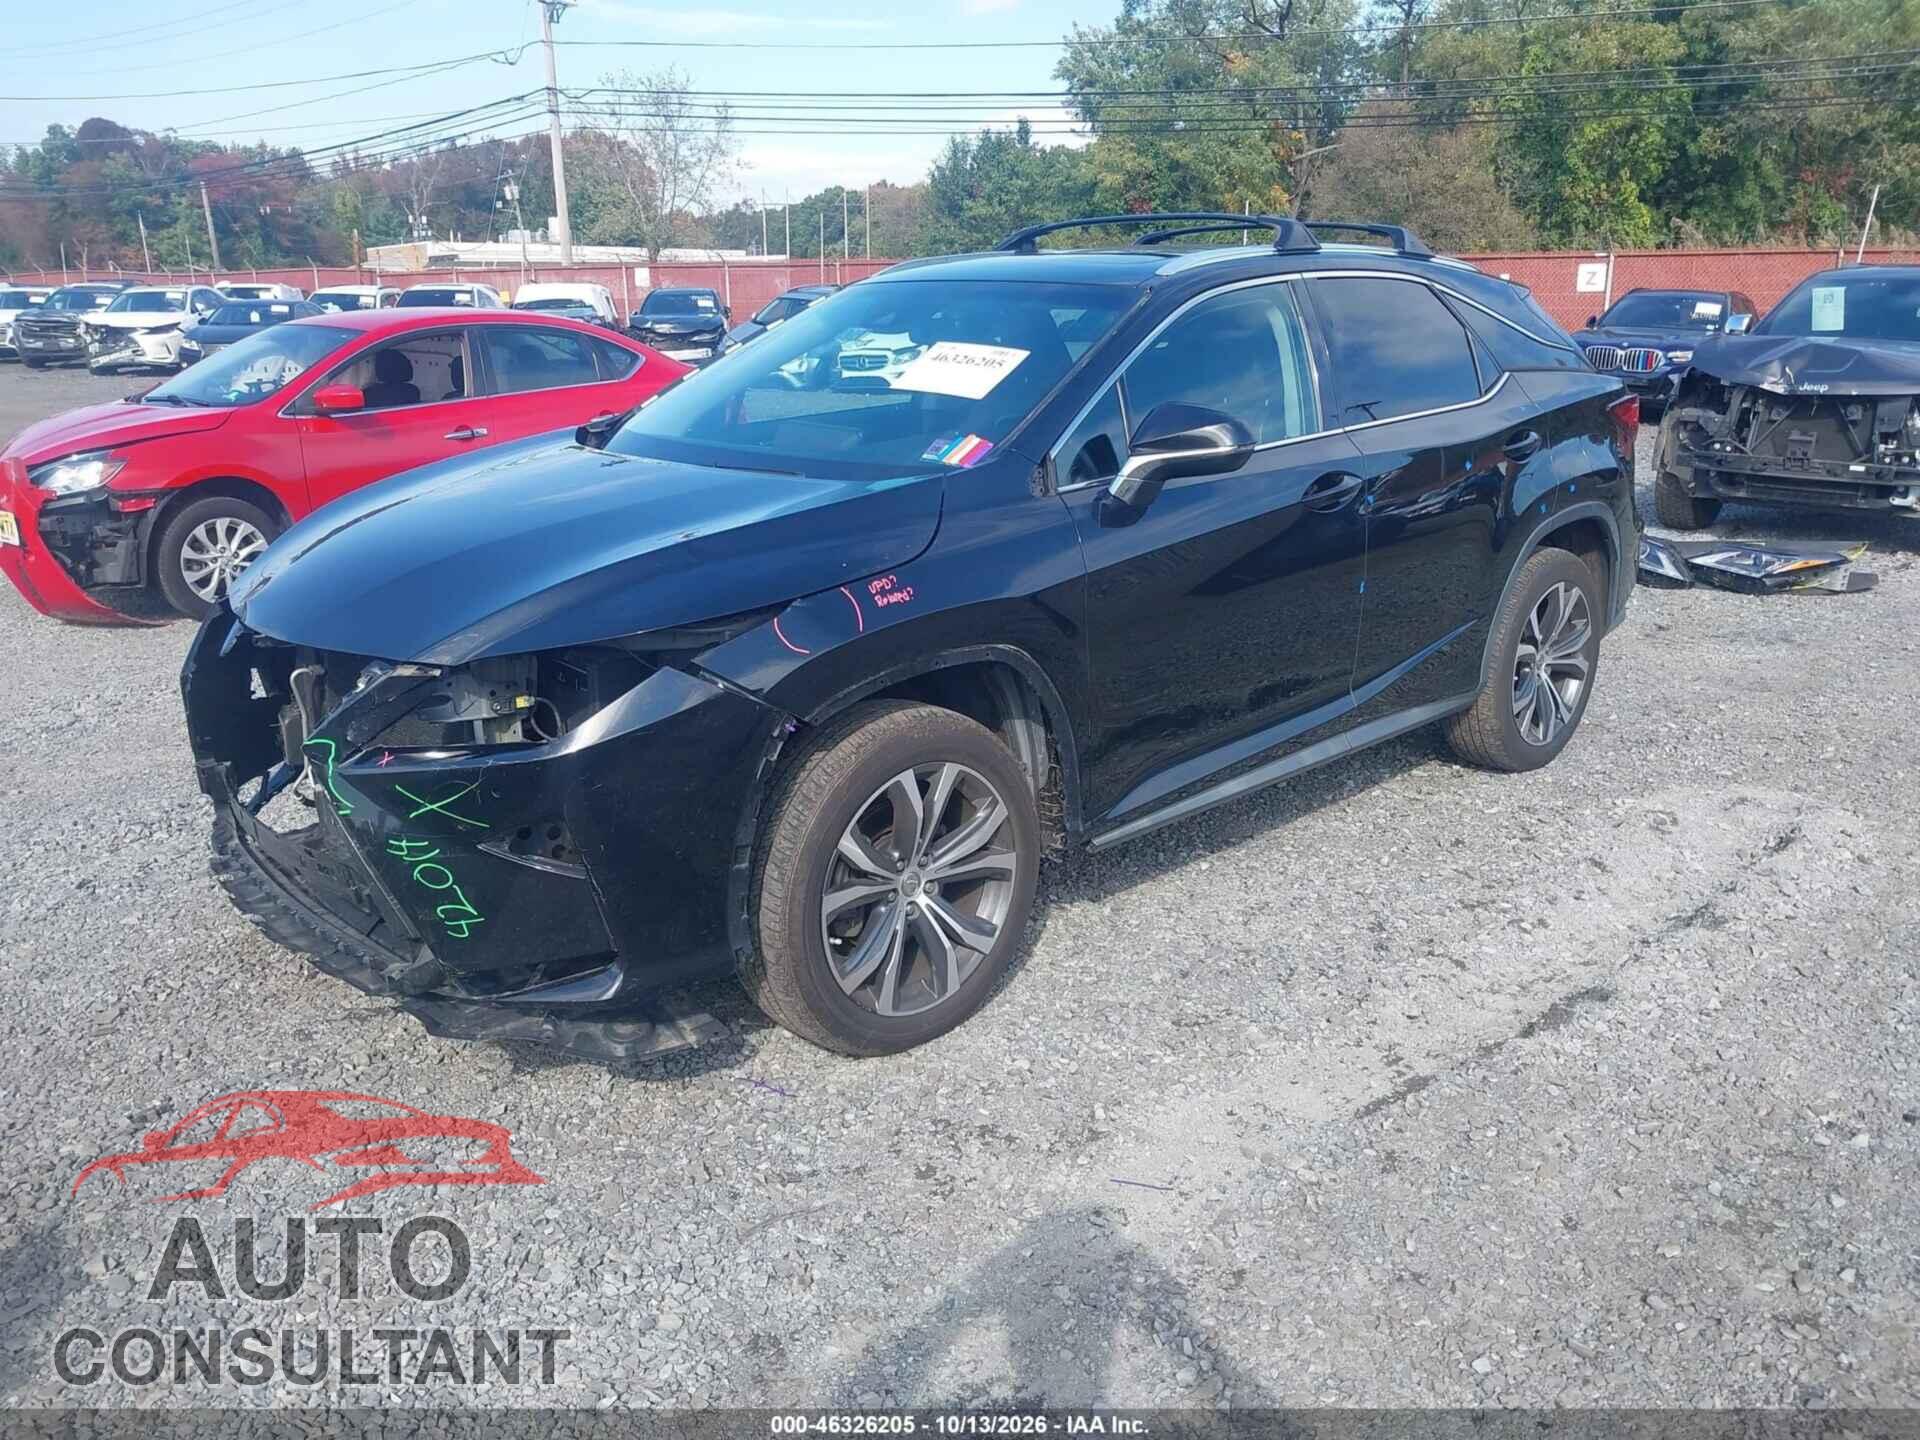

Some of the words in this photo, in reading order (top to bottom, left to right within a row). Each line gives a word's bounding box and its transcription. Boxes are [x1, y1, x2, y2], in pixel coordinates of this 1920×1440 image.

[1585, 271, 1598, 286] Z
[930, 351, 1008, 369] 46326205
[1799, 382, 1829, 393] Jeep
